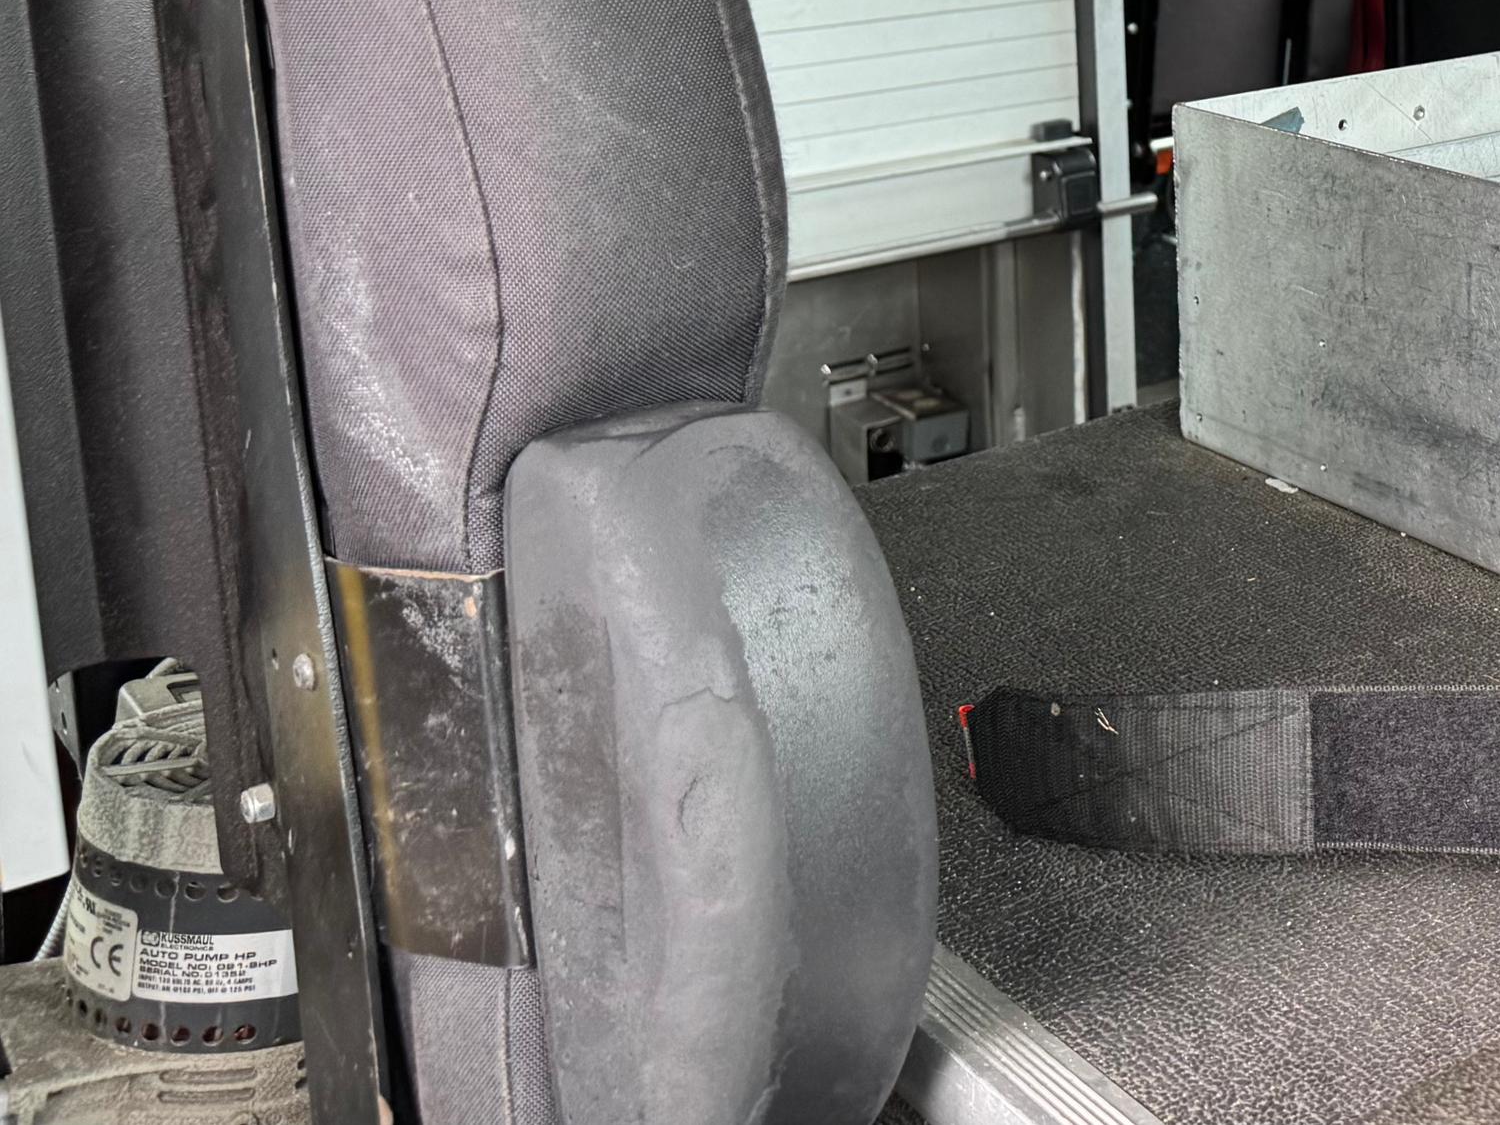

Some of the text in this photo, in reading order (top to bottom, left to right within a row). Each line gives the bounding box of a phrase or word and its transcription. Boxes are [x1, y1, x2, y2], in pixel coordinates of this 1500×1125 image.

[161, 932, 214, 945] KUSSMAUL
[161, 943, 214, 951] ELECTRONICS
[140, 948, 257, 962] AUTO PUMP HP
[140, 958, 183, 970] MODEL
[140, 965, 178, 977] SERIAL
